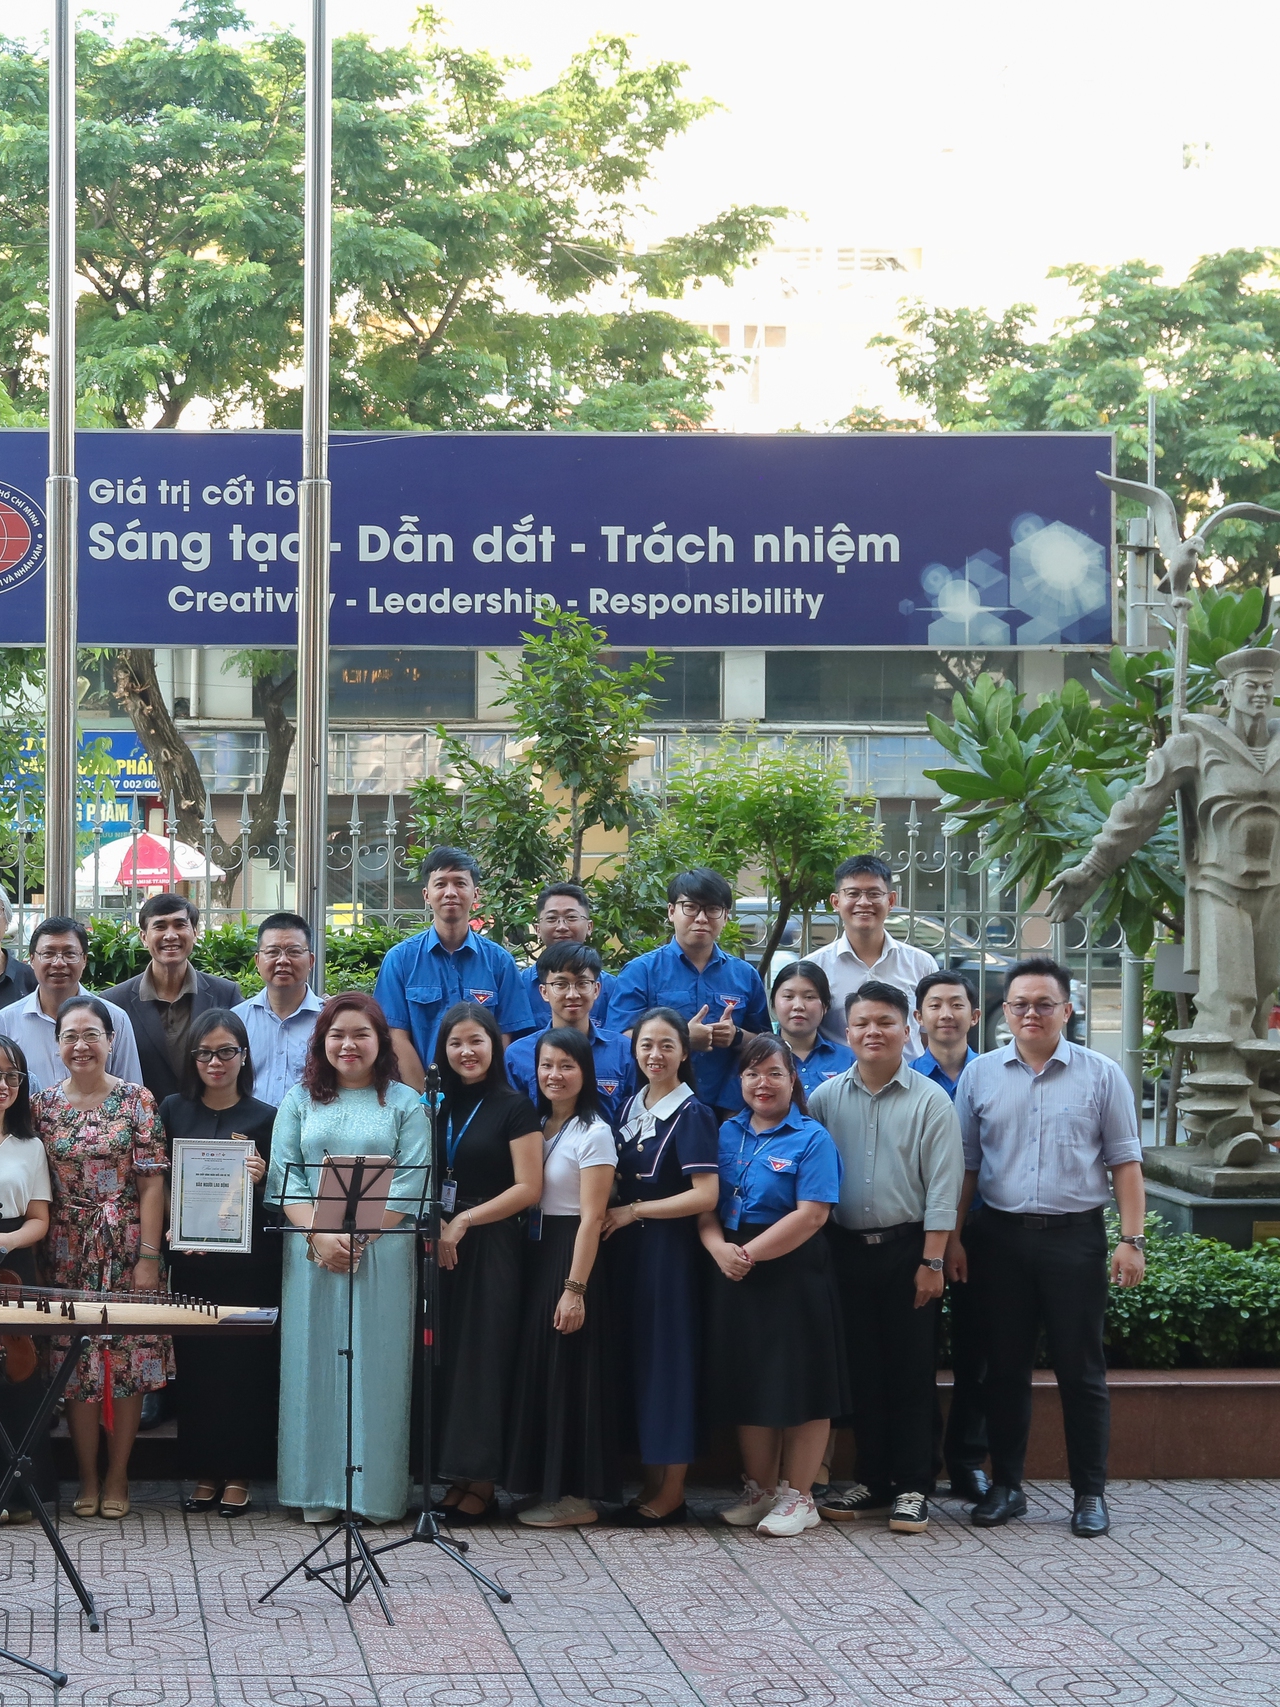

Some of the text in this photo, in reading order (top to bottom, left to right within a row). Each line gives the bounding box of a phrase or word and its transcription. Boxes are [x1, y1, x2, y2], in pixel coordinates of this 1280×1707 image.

[89, 474, 299, 512] Giá trị cốt lõ
[23, 505, 41, 527] MINH
[88, 518, 211, 572] Sáng
[358, 514, 454, 563] Dẫn
[472, 513, 556, 563] dắt
[601, 521, 734, 563] Trách
[754, 522, 901, 573] nhiệm
[368, 586, 556, 619] Leadership
[589, 587, 824, 620] Responsibility
